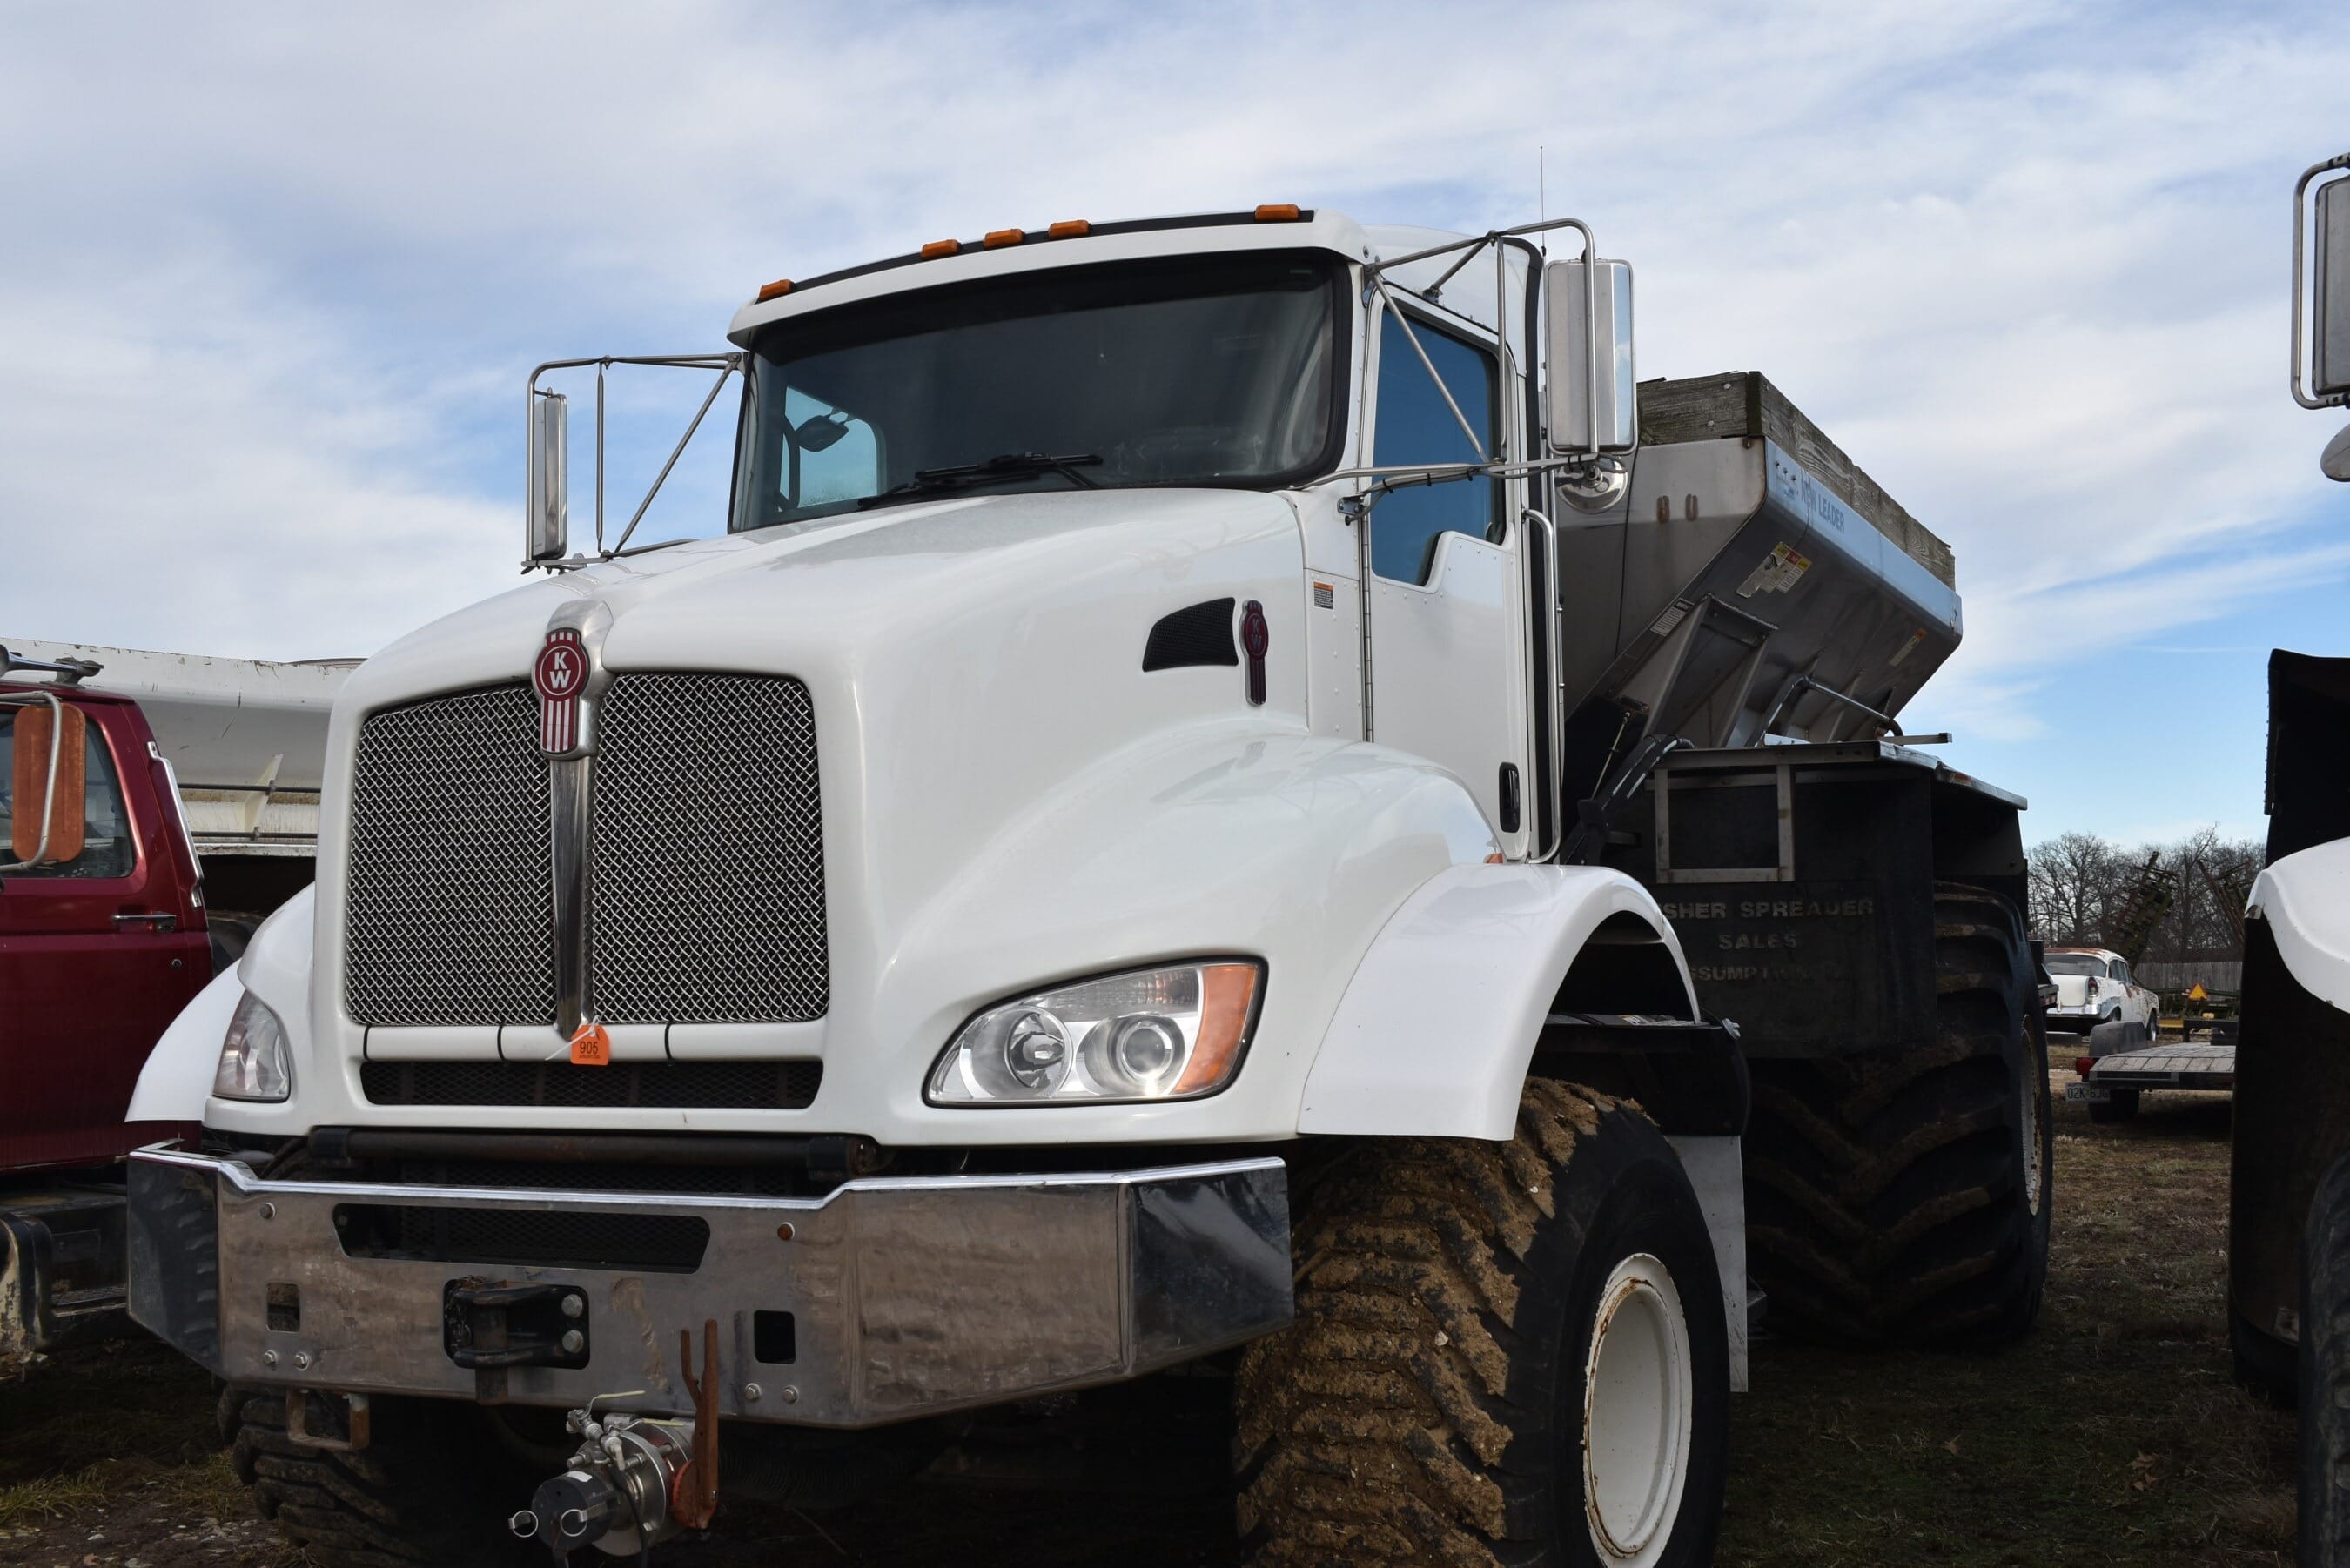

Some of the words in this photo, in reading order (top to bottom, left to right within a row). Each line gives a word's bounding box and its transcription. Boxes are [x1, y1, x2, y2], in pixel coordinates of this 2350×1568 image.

[1818, 493, 1844, 535] LEADER
[1252, 618, 1260, 634] K
[1250, 633, 1262, 649] W
[554, 651, 567, 670] K
[549, 670, 571, 689] W
[1660, 901, 1727, 919] SHER
[1740, 900, 1874, 918] SPREADER
[1719, 932, 1797, 950] SALES
[580, 1041, 599, 1055] 905
